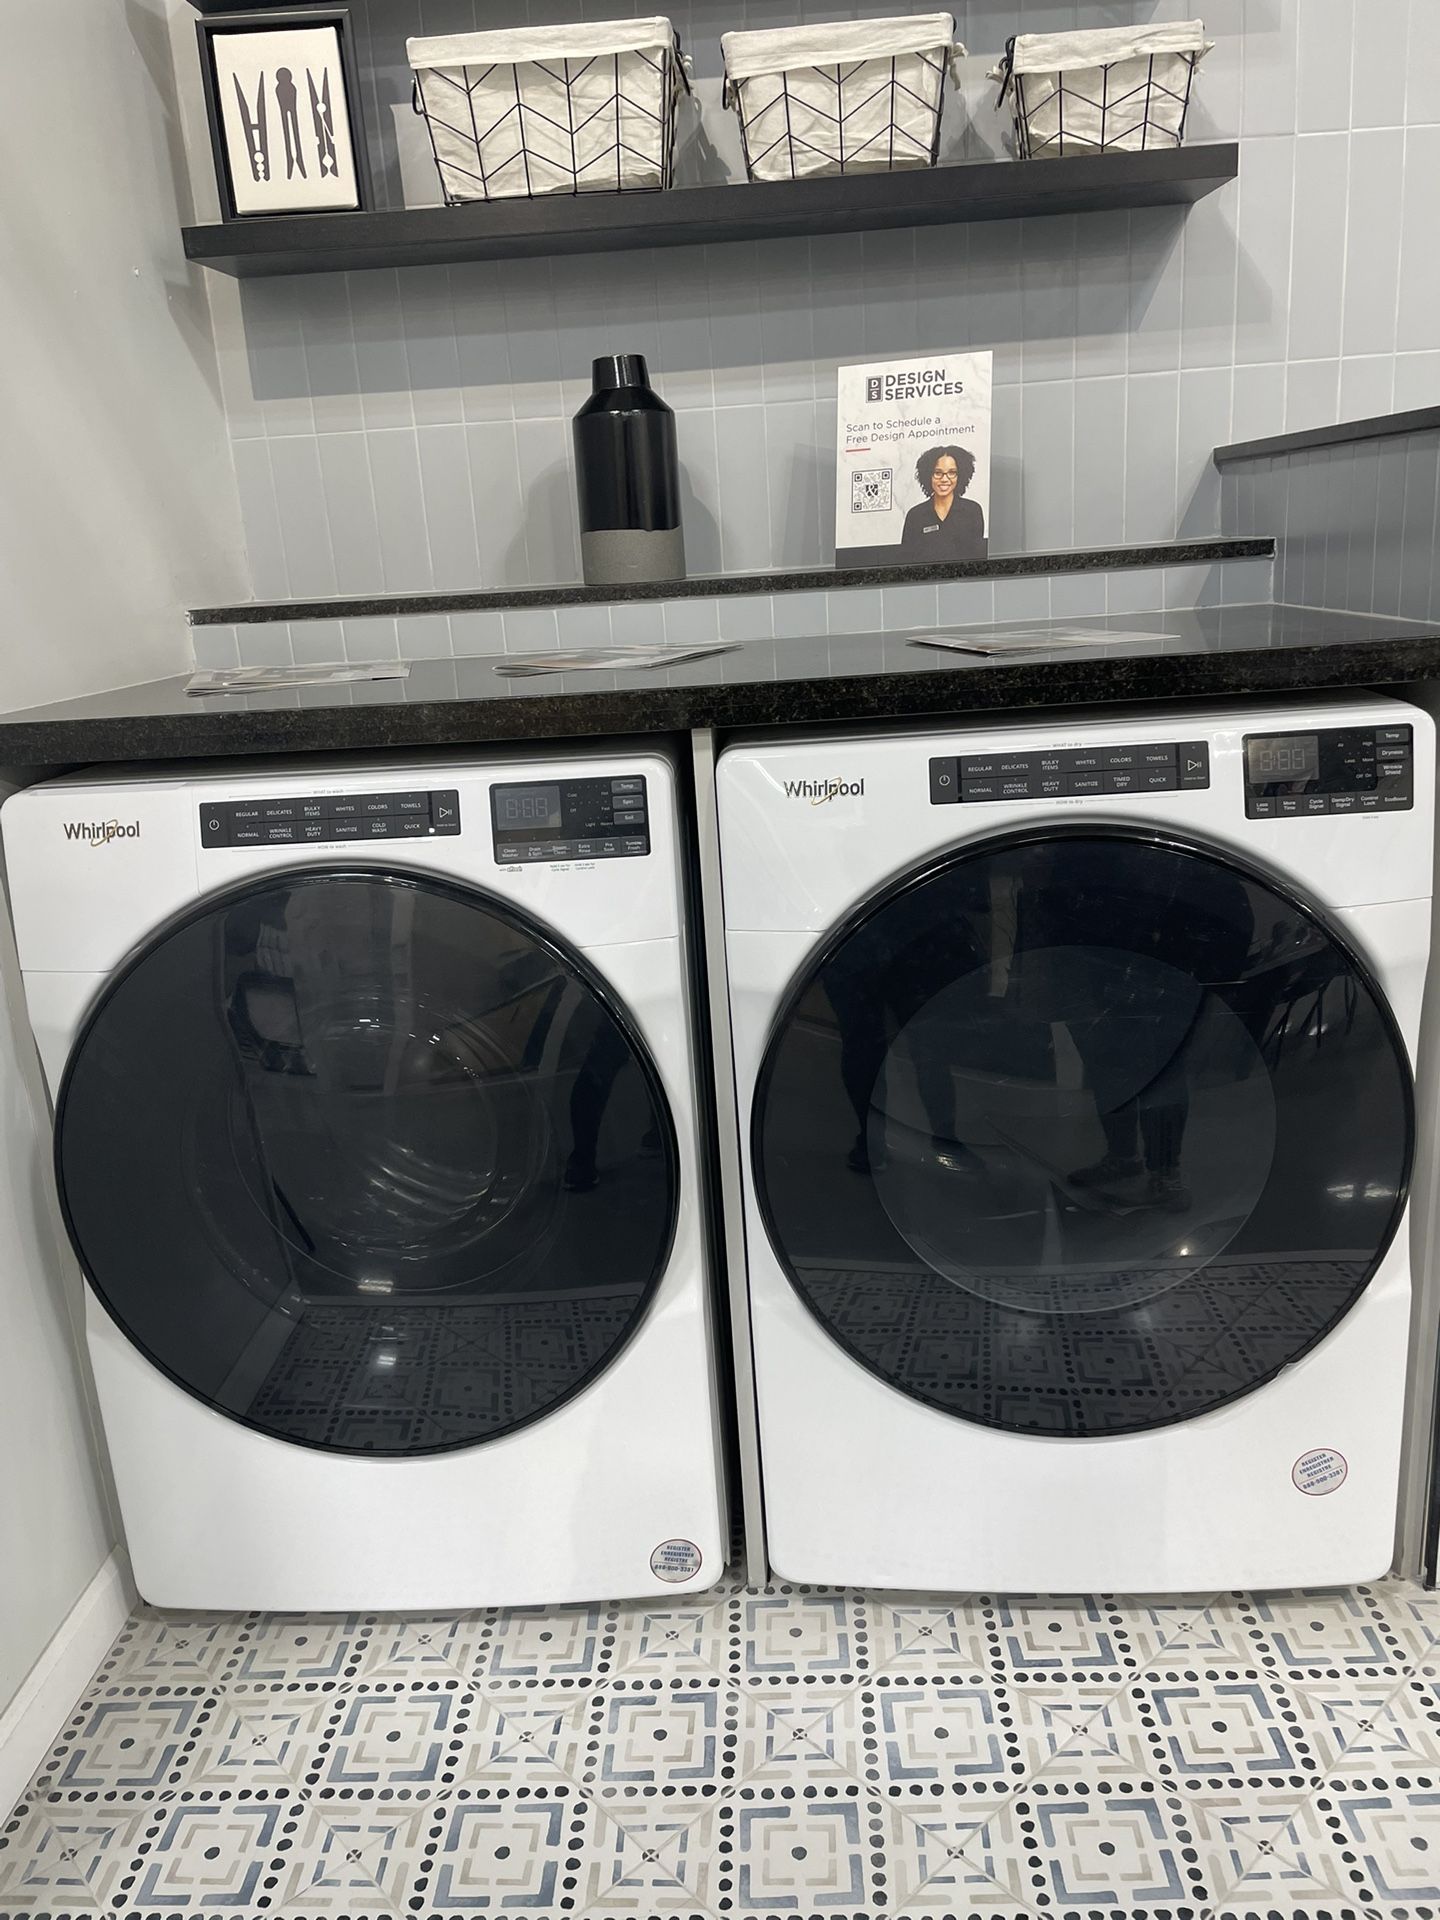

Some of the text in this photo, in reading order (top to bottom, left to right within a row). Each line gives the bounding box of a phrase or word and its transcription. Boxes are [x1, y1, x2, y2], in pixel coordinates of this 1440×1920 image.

[871, 380, 878, 388] D
[886, 369, 945, 386] DESIGN
[871, 391, 878, 399] S
[885, 382, 963, 400] SERVICES
[846, 423, 870, 432] Scan
[873, 422, 883, 430] to
[886, 417, 932, 429] Schedule
[846, 425, 975, 444] Free Design Appointment
[783, 778, 864, 800] Whirlpool
[63, 821, 140, 843] Whirlpool
[1299, 1456, 1334, 1474] ENREGISTRER
[1301, 1453, 1326, 1466] REGISTER
[1307, 1464, 1332, 1477] REGISTRE
